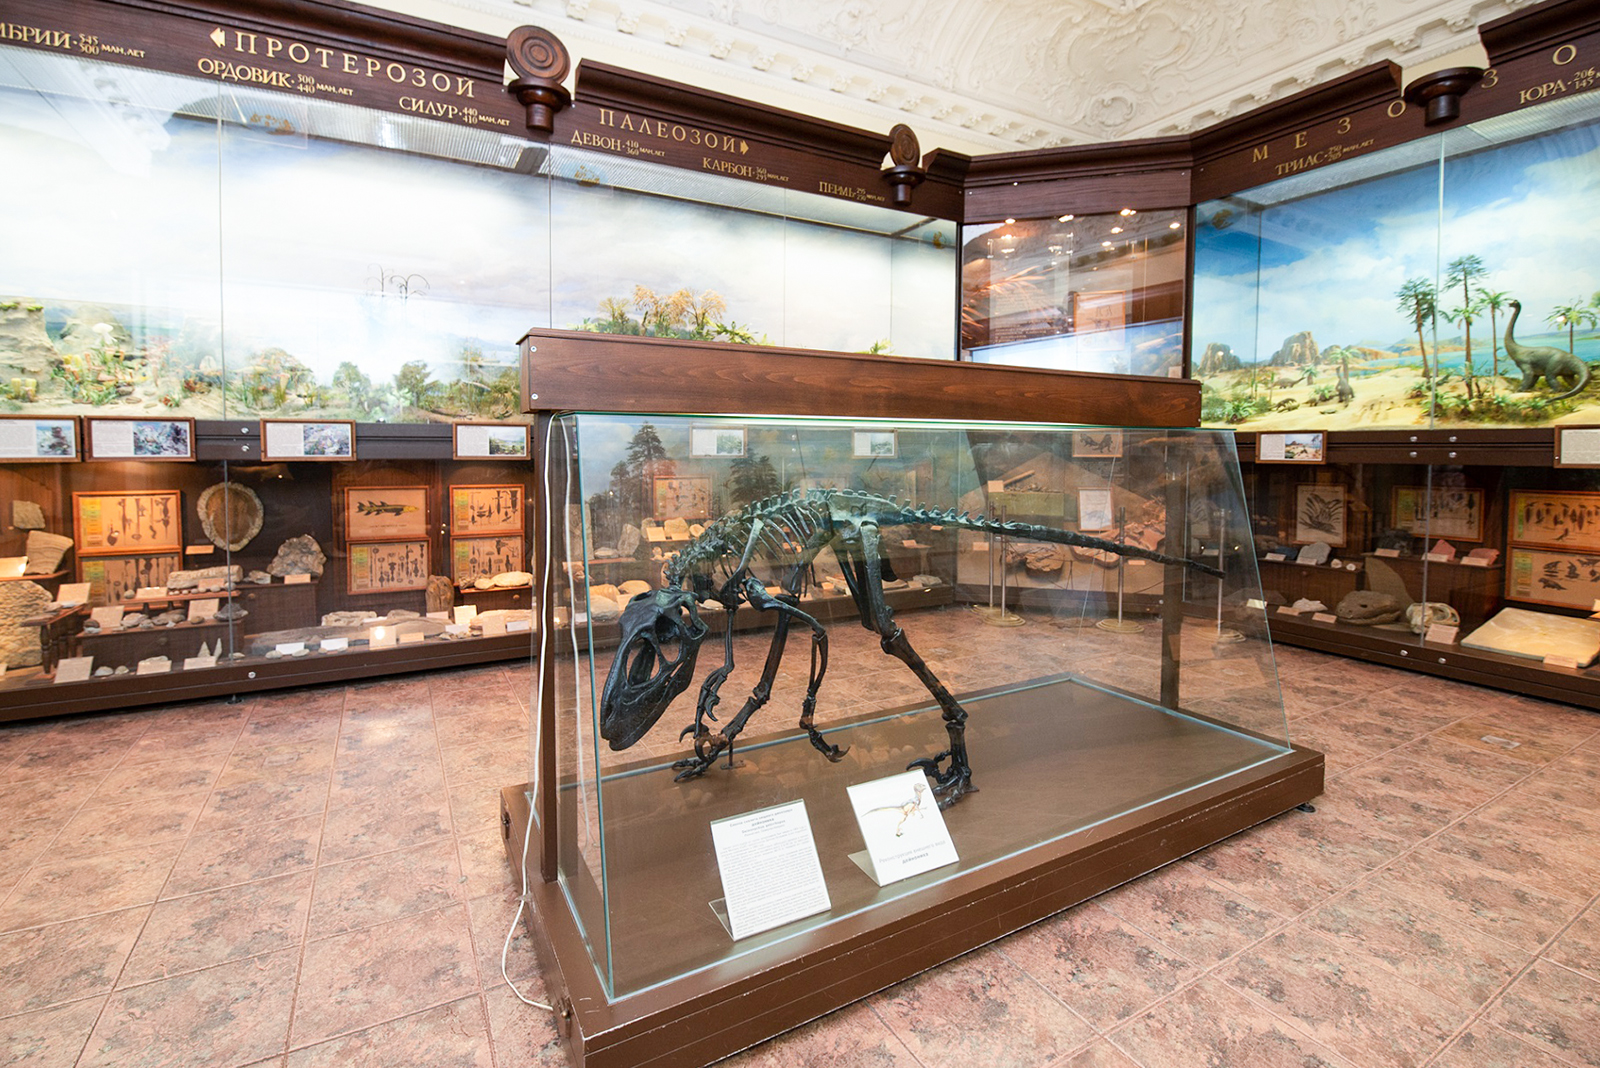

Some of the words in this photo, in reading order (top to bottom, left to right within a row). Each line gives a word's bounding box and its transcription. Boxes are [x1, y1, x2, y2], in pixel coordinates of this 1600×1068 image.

[79, 43, 99, 55] 500
[234, 31, 475, 98] ПРОТЕРОЗОЙ
[297, 73, 315, 84] 500
[1574, 66, 1595, 80] 206
[297, 84, 315, 94] 440
[463, 107, 478, 117] 440
[463, 115, 478, 125] 410
[599, 107, 735, 153] ПАЛЕОЗОЙ
